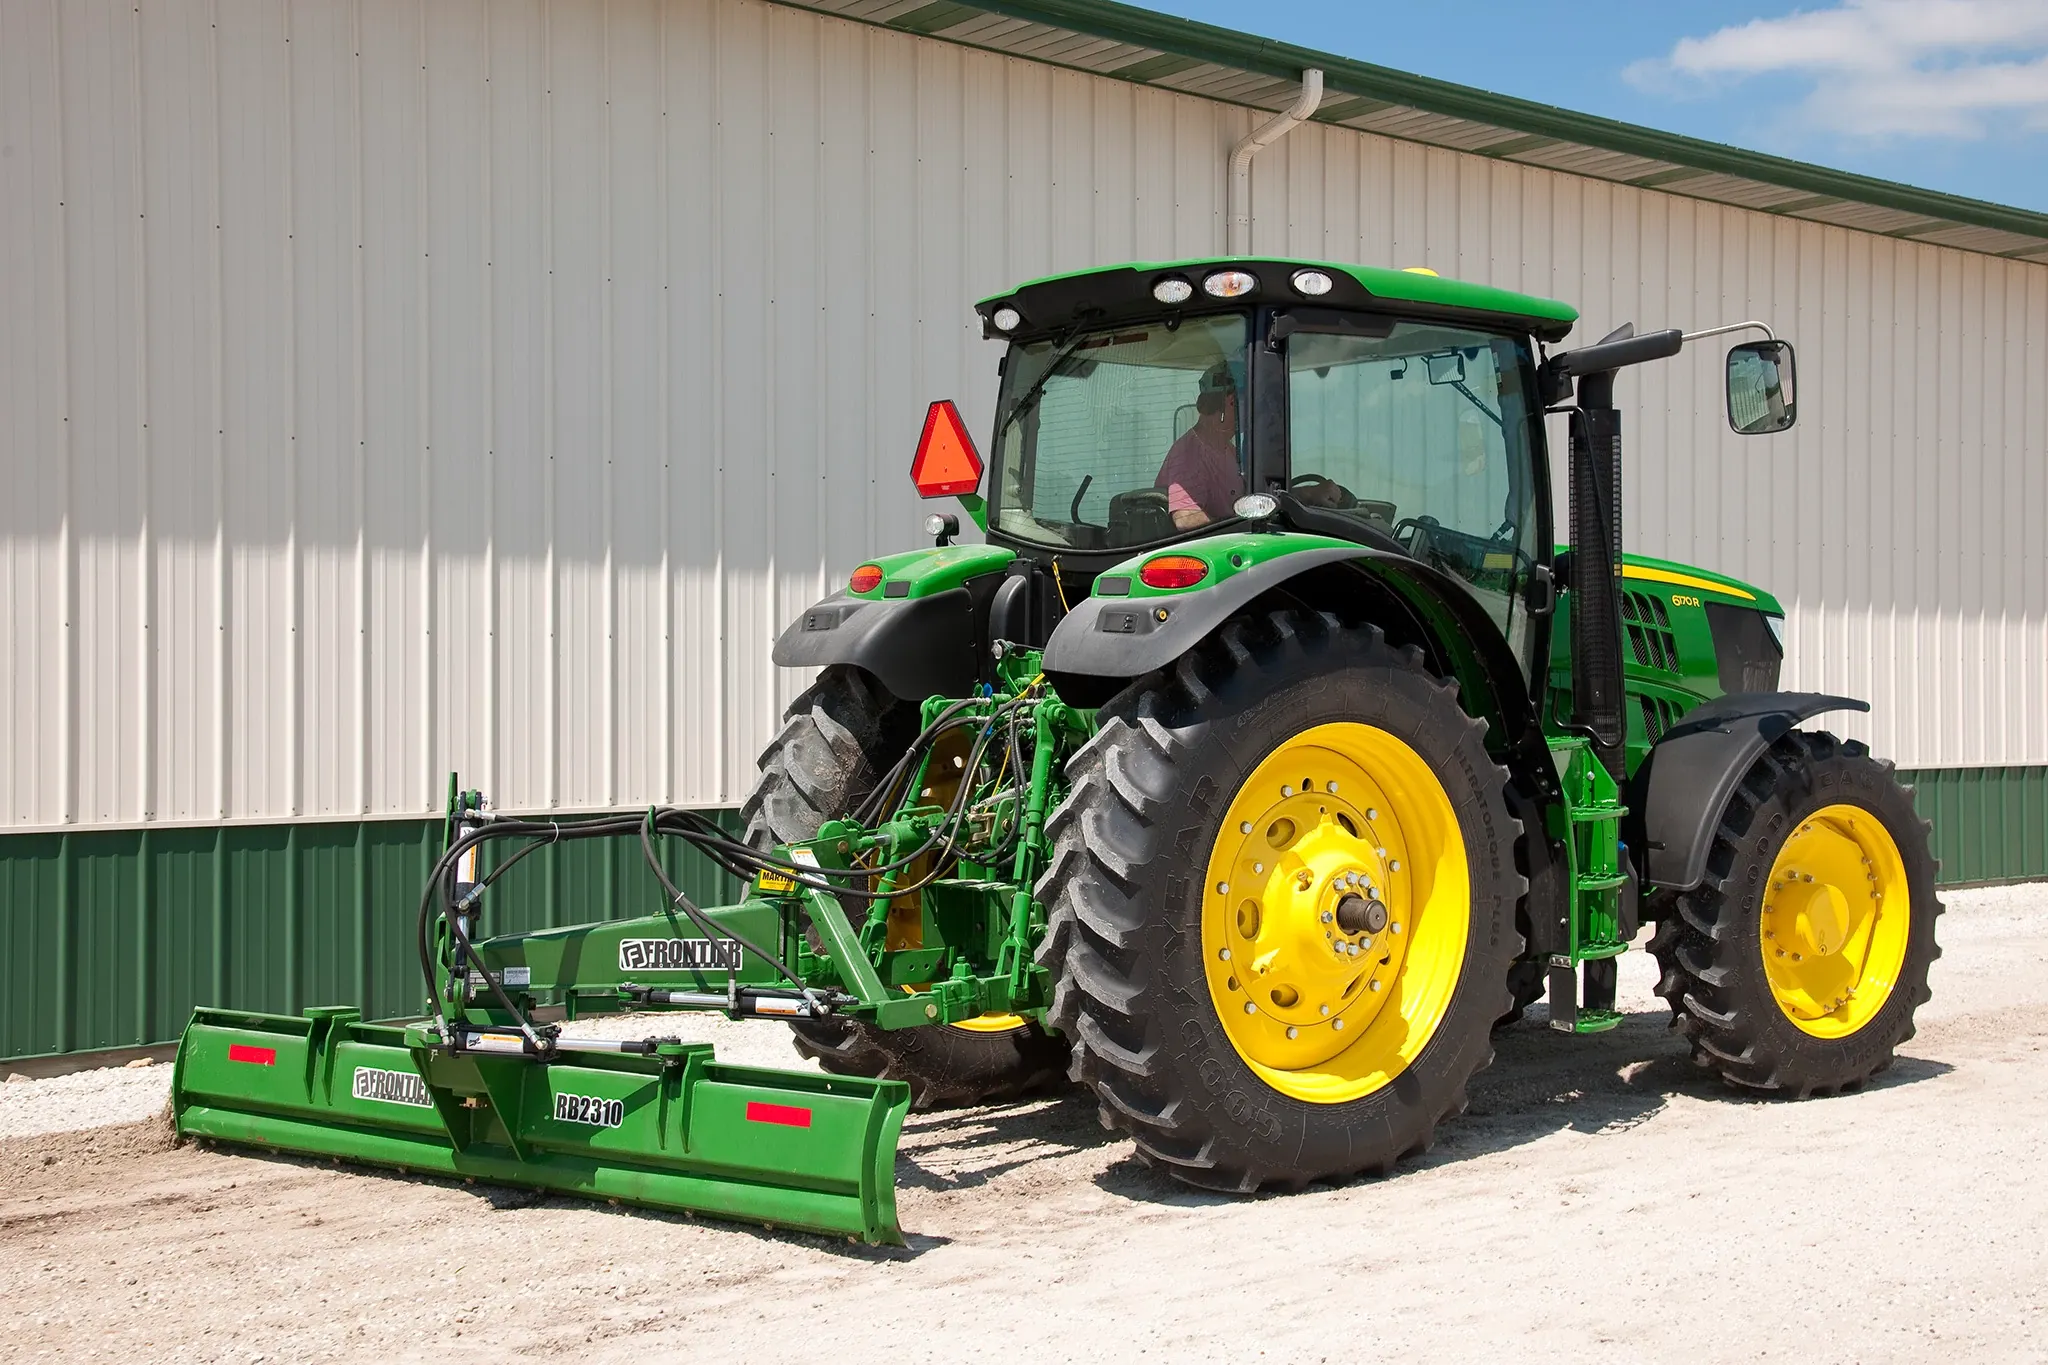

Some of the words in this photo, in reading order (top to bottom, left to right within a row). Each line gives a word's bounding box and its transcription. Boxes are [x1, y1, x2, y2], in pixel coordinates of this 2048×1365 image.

[1740, 769, 1876, 916] GOODEAR
[1162, 774, 1284, 1144] GOODYEAR
[557, 1094, 624, 1127] RB2310
